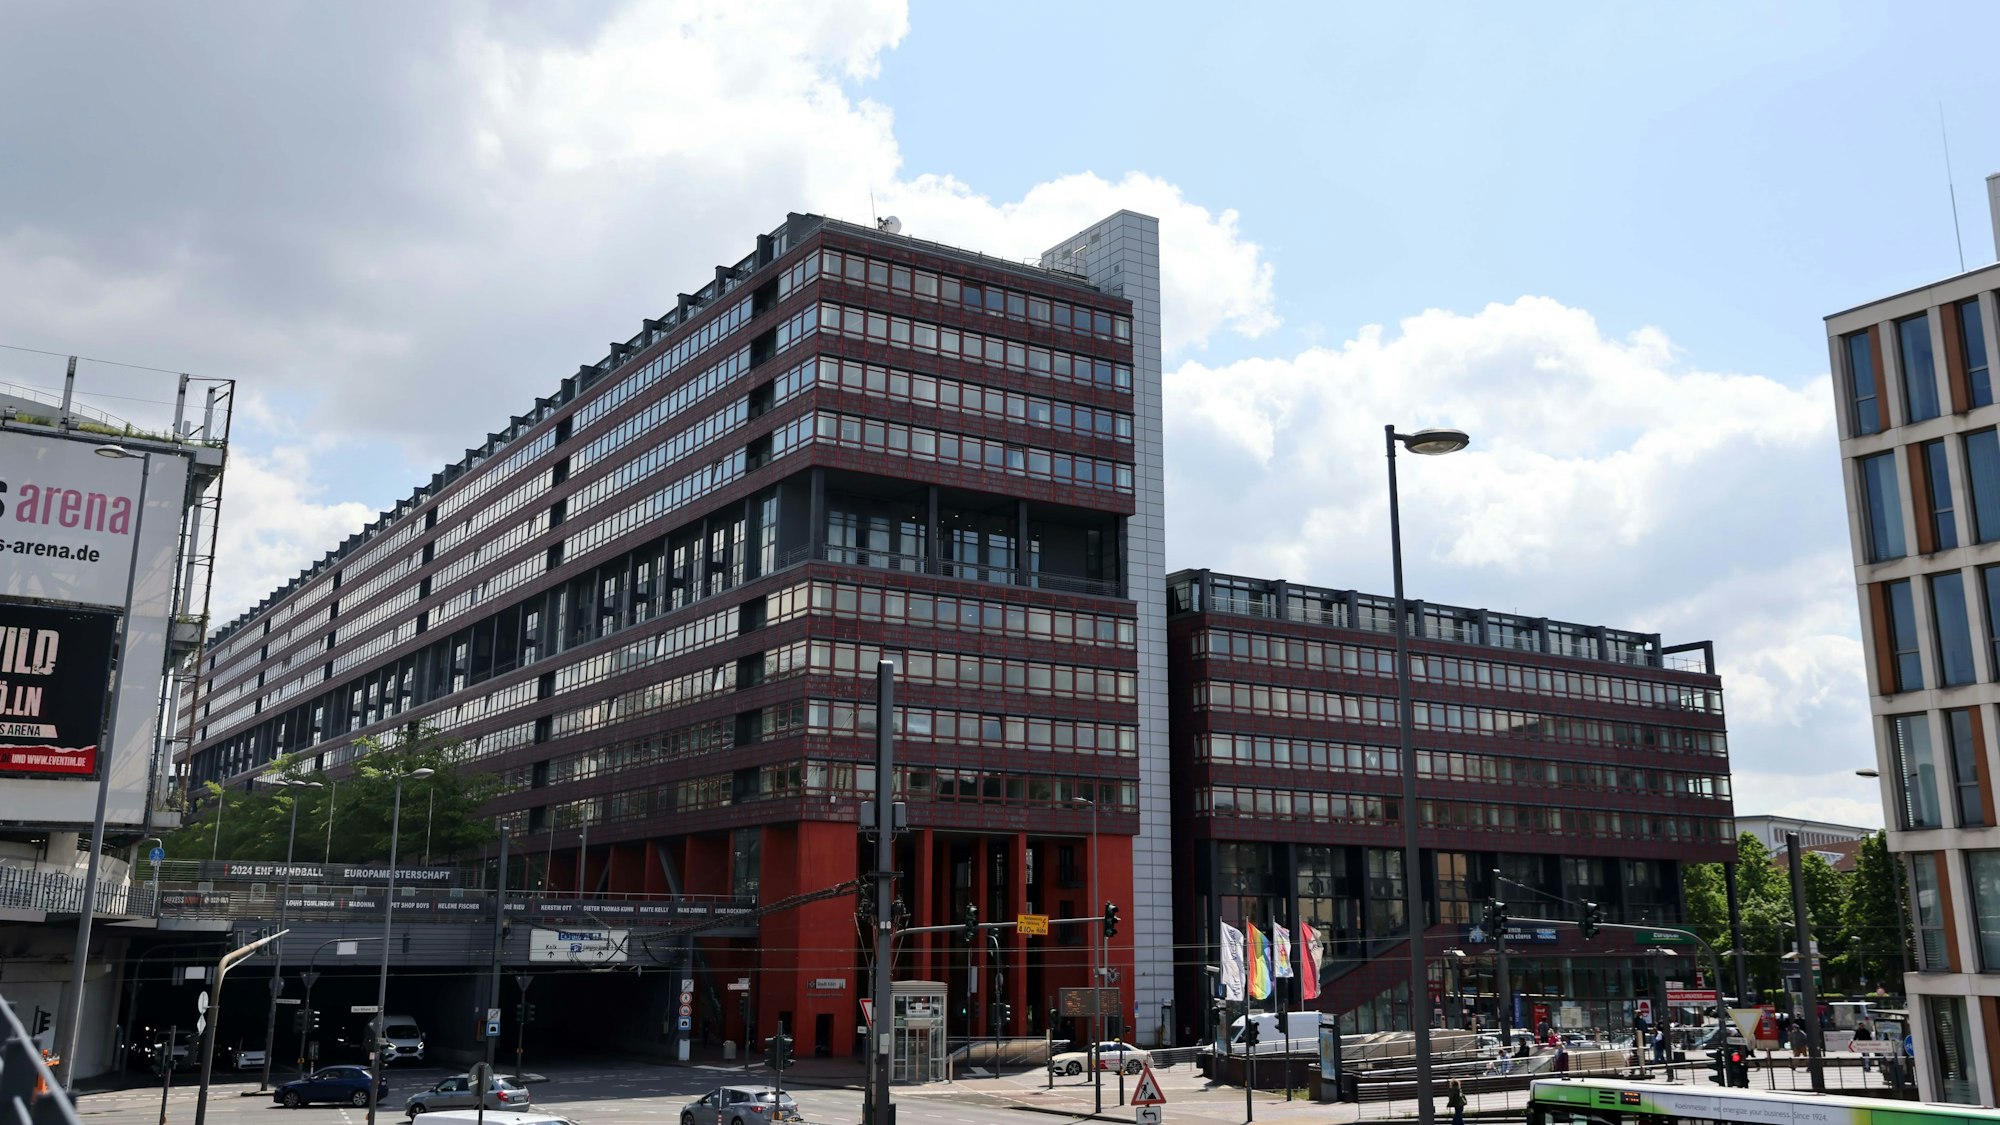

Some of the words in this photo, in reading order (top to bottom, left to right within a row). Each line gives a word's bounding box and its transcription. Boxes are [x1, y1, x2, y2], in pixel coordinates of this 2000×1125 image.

[15, 484, 131, 535] arena
[7, 725, 41, 736] ARENA
[11, 754, 26, 764] UND
[27, 754, 86, 767] WWW.EVENTIM.DE
[231, 866, 252, 875] 2024
[254, 866, 273, 875] EHF
[275, 867, 324, 876] HANDBALL
[344, 869, 450, 880] EUROPAMESTERSCHAFT
[1723, 1107, 1747, 1115] energize
[1750, 1109, 1764, 1117] your
[1793, 1112, 1810, 1120] Since
